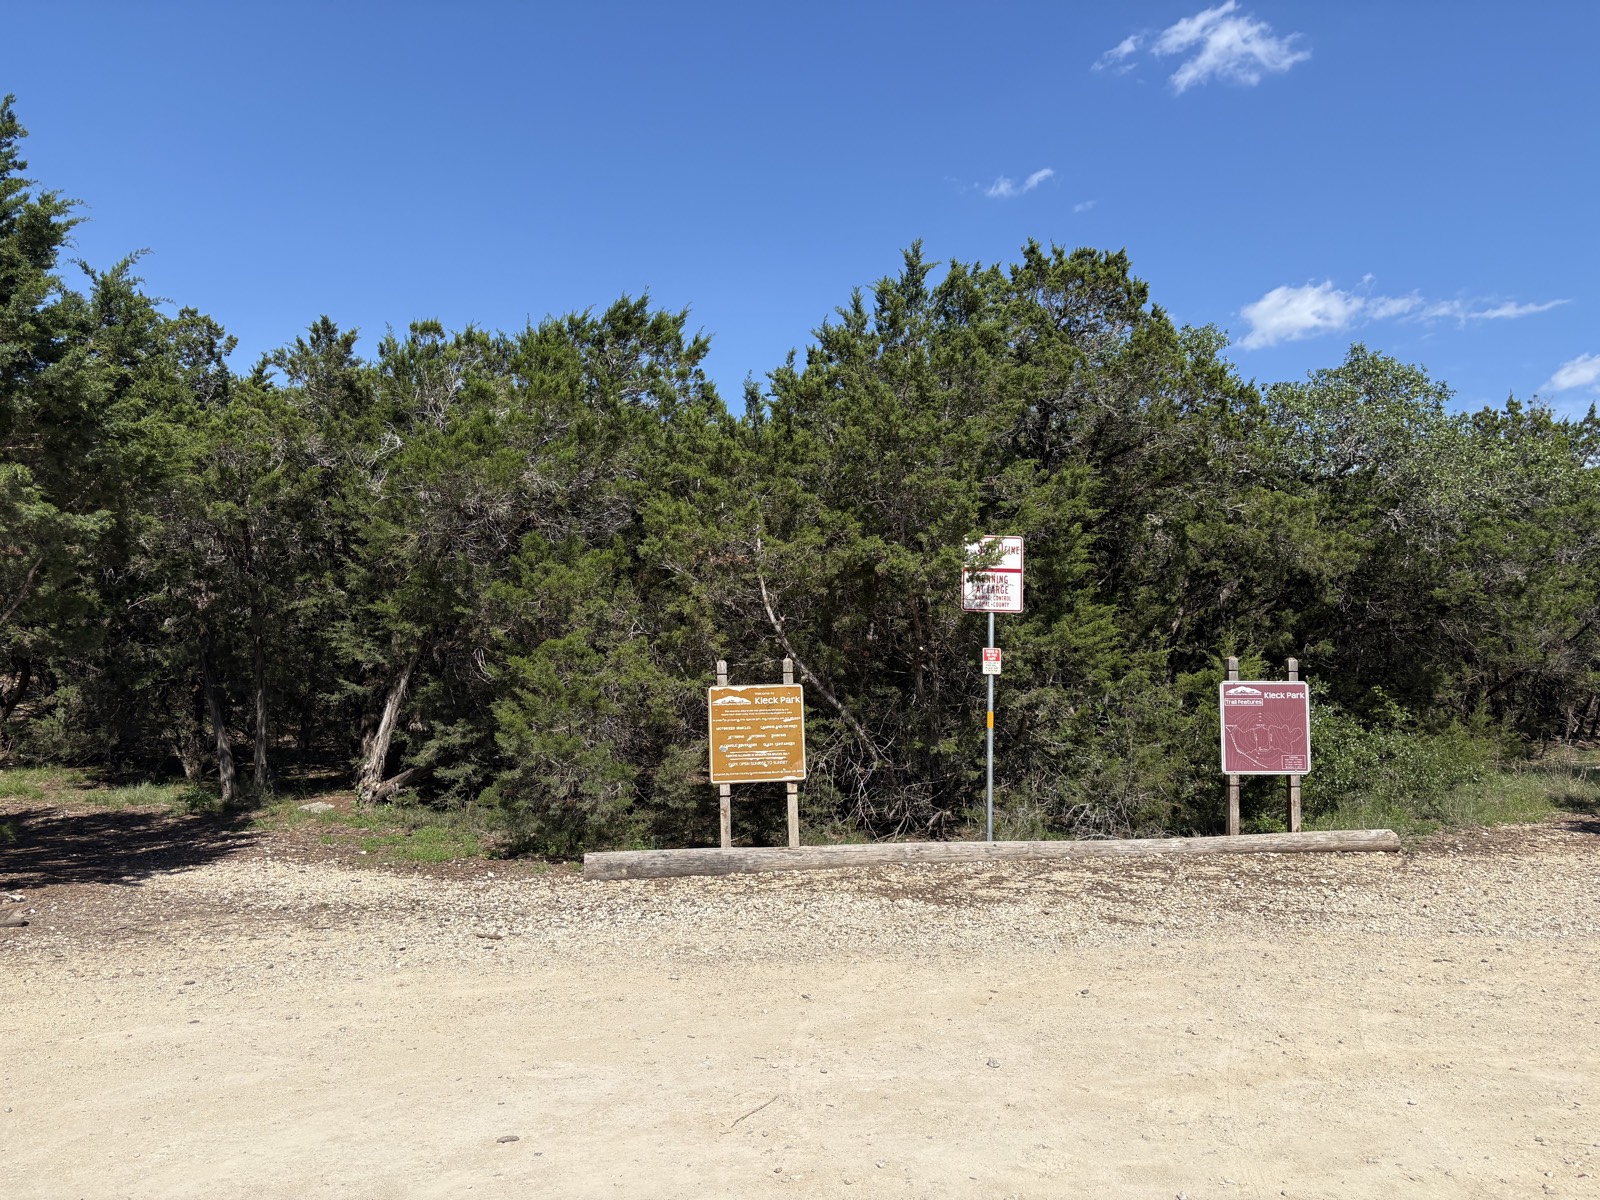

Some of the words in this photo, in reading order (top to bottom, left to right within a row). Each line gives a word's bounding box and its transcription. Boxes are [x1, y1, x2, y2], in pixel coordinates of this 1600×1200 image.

[976, 585, 984, 593] AT
[987, 585, 1009, 594] LARGE
[780, 696, 801, 704] Park
